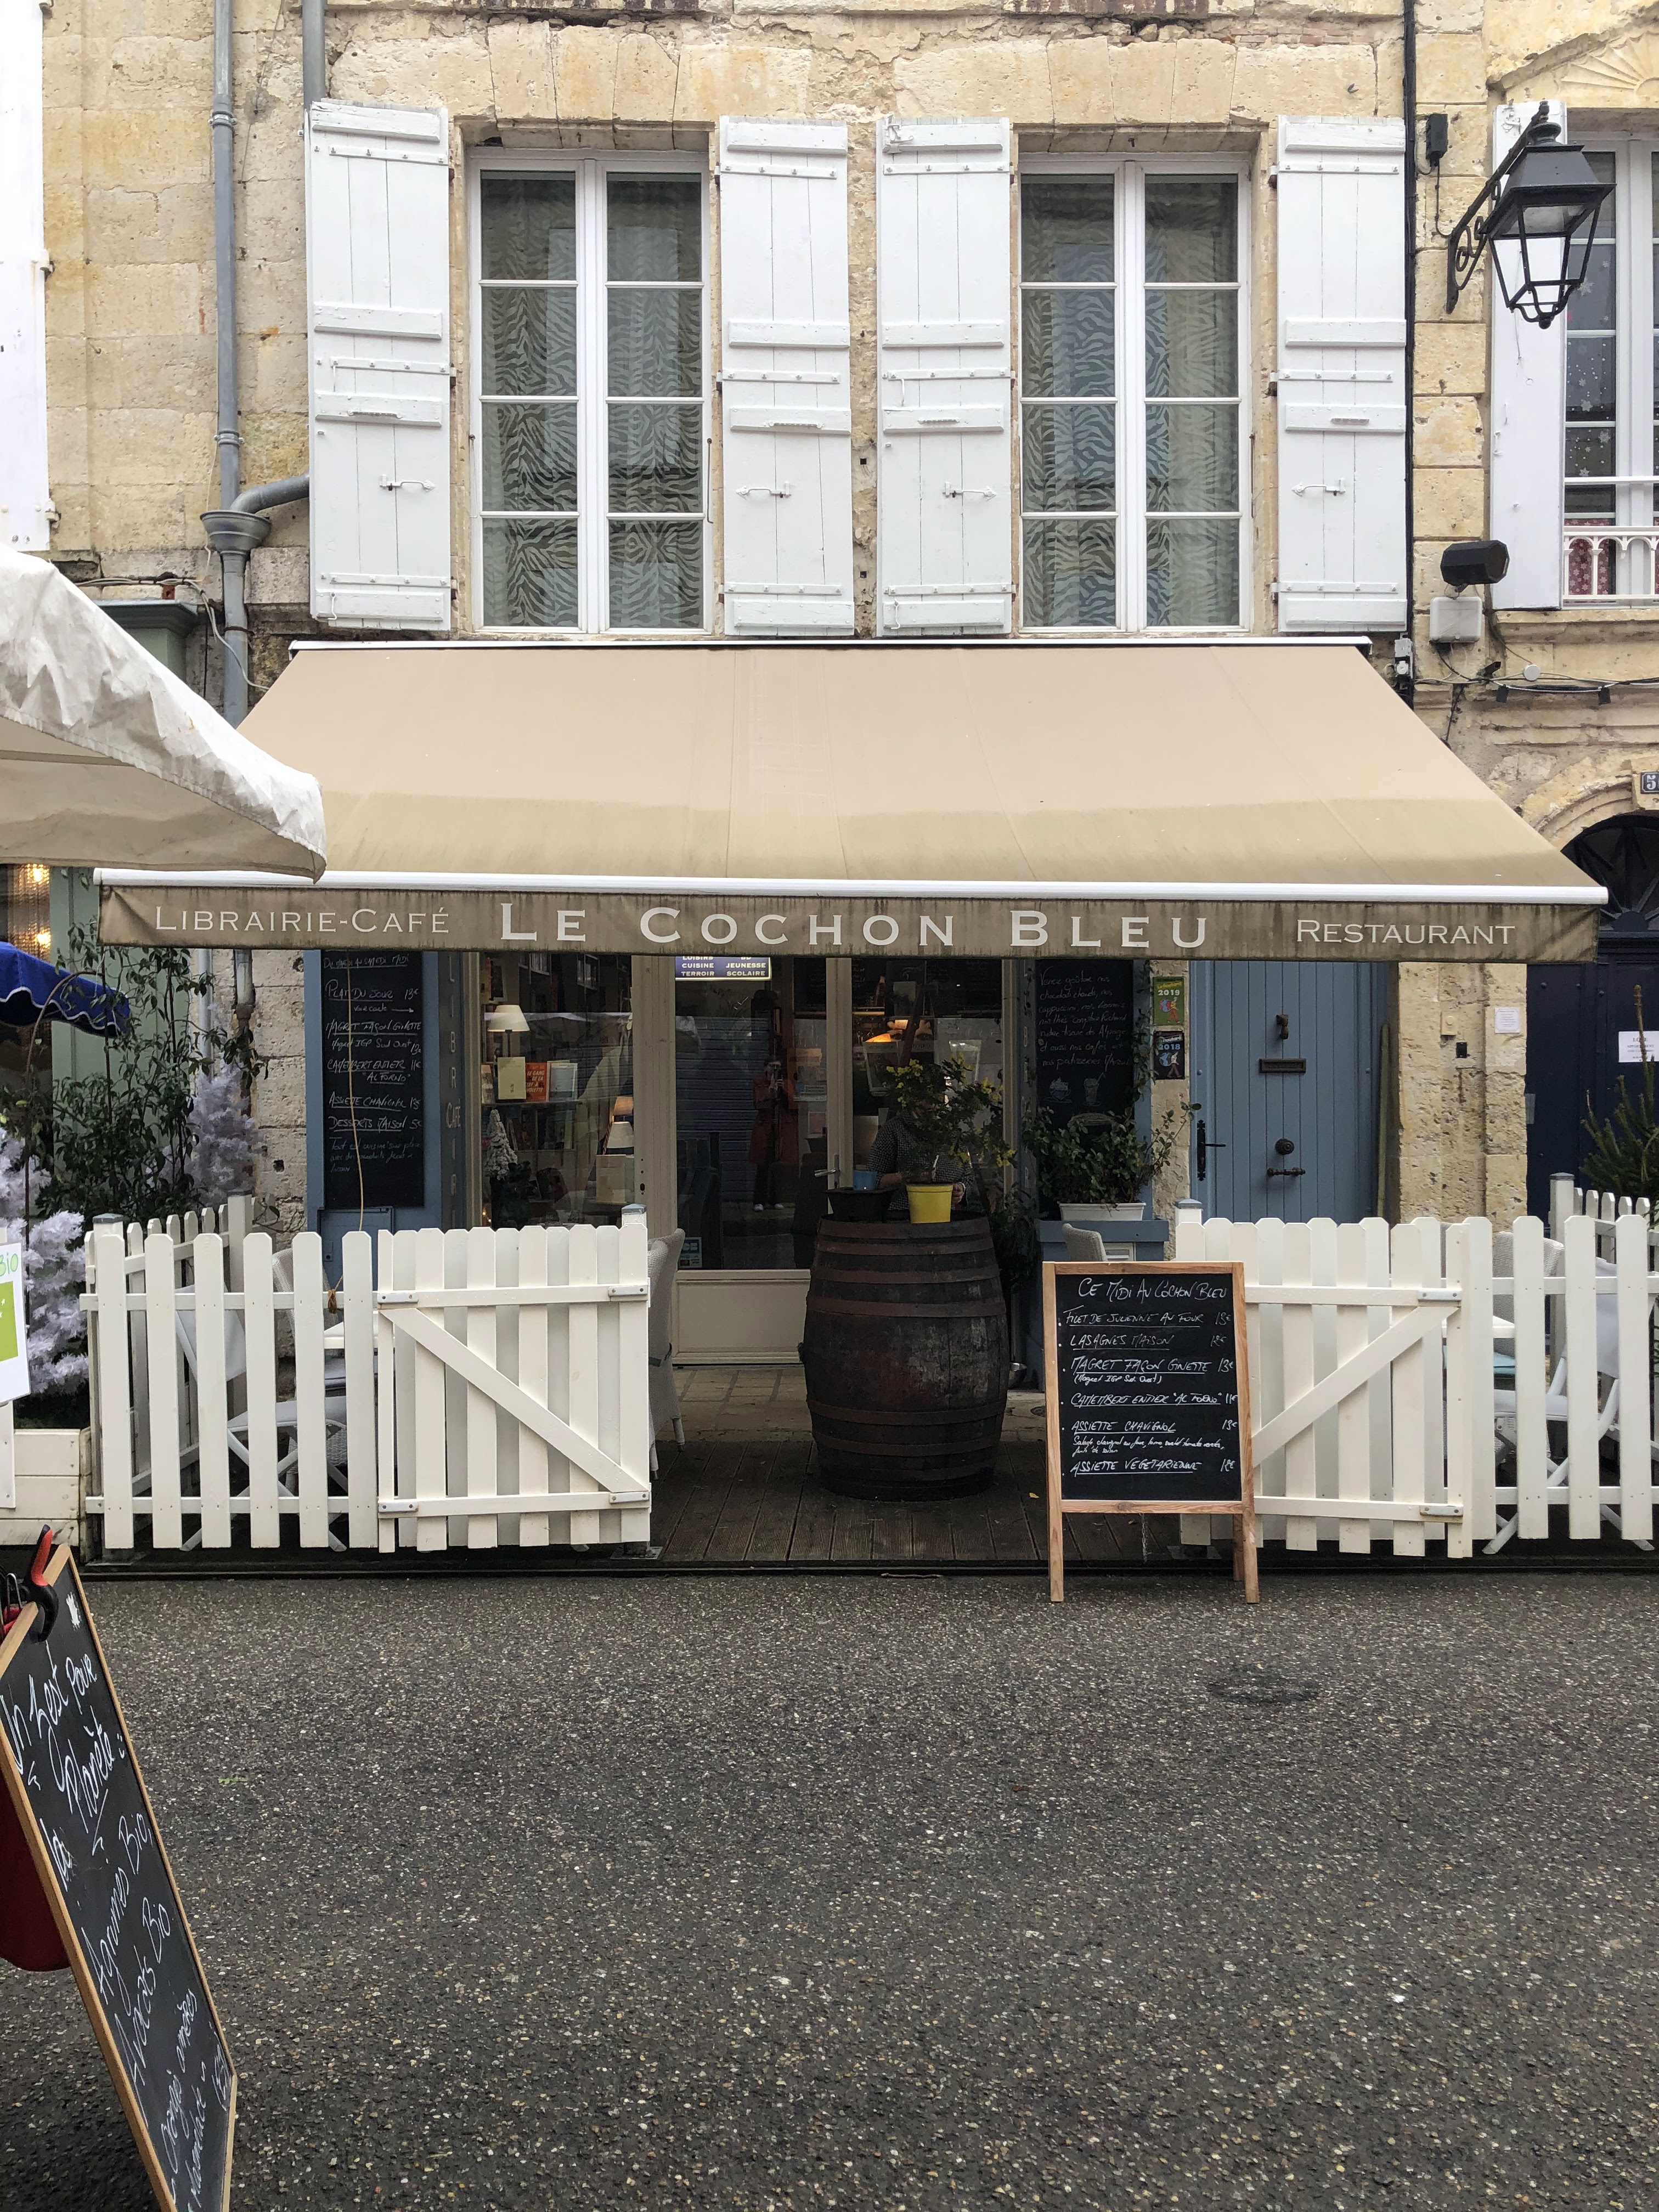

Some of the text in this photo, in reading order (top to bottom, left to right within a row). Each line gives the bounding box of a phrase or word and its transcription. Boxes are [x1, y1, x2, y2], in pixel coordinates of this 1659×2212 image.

[1646, 775, 1659, 790] 5
[155, 906, 449, 933] LIBRAIRIE-CAFÉ
[500, 902, 1207, 949] LE COCHON BLEU
[1296, 919, 1516, 945] RESTAURANT
[1077, 1277, 1104, 1297] CE
[1088, 1313, 1104, 1324] DE
